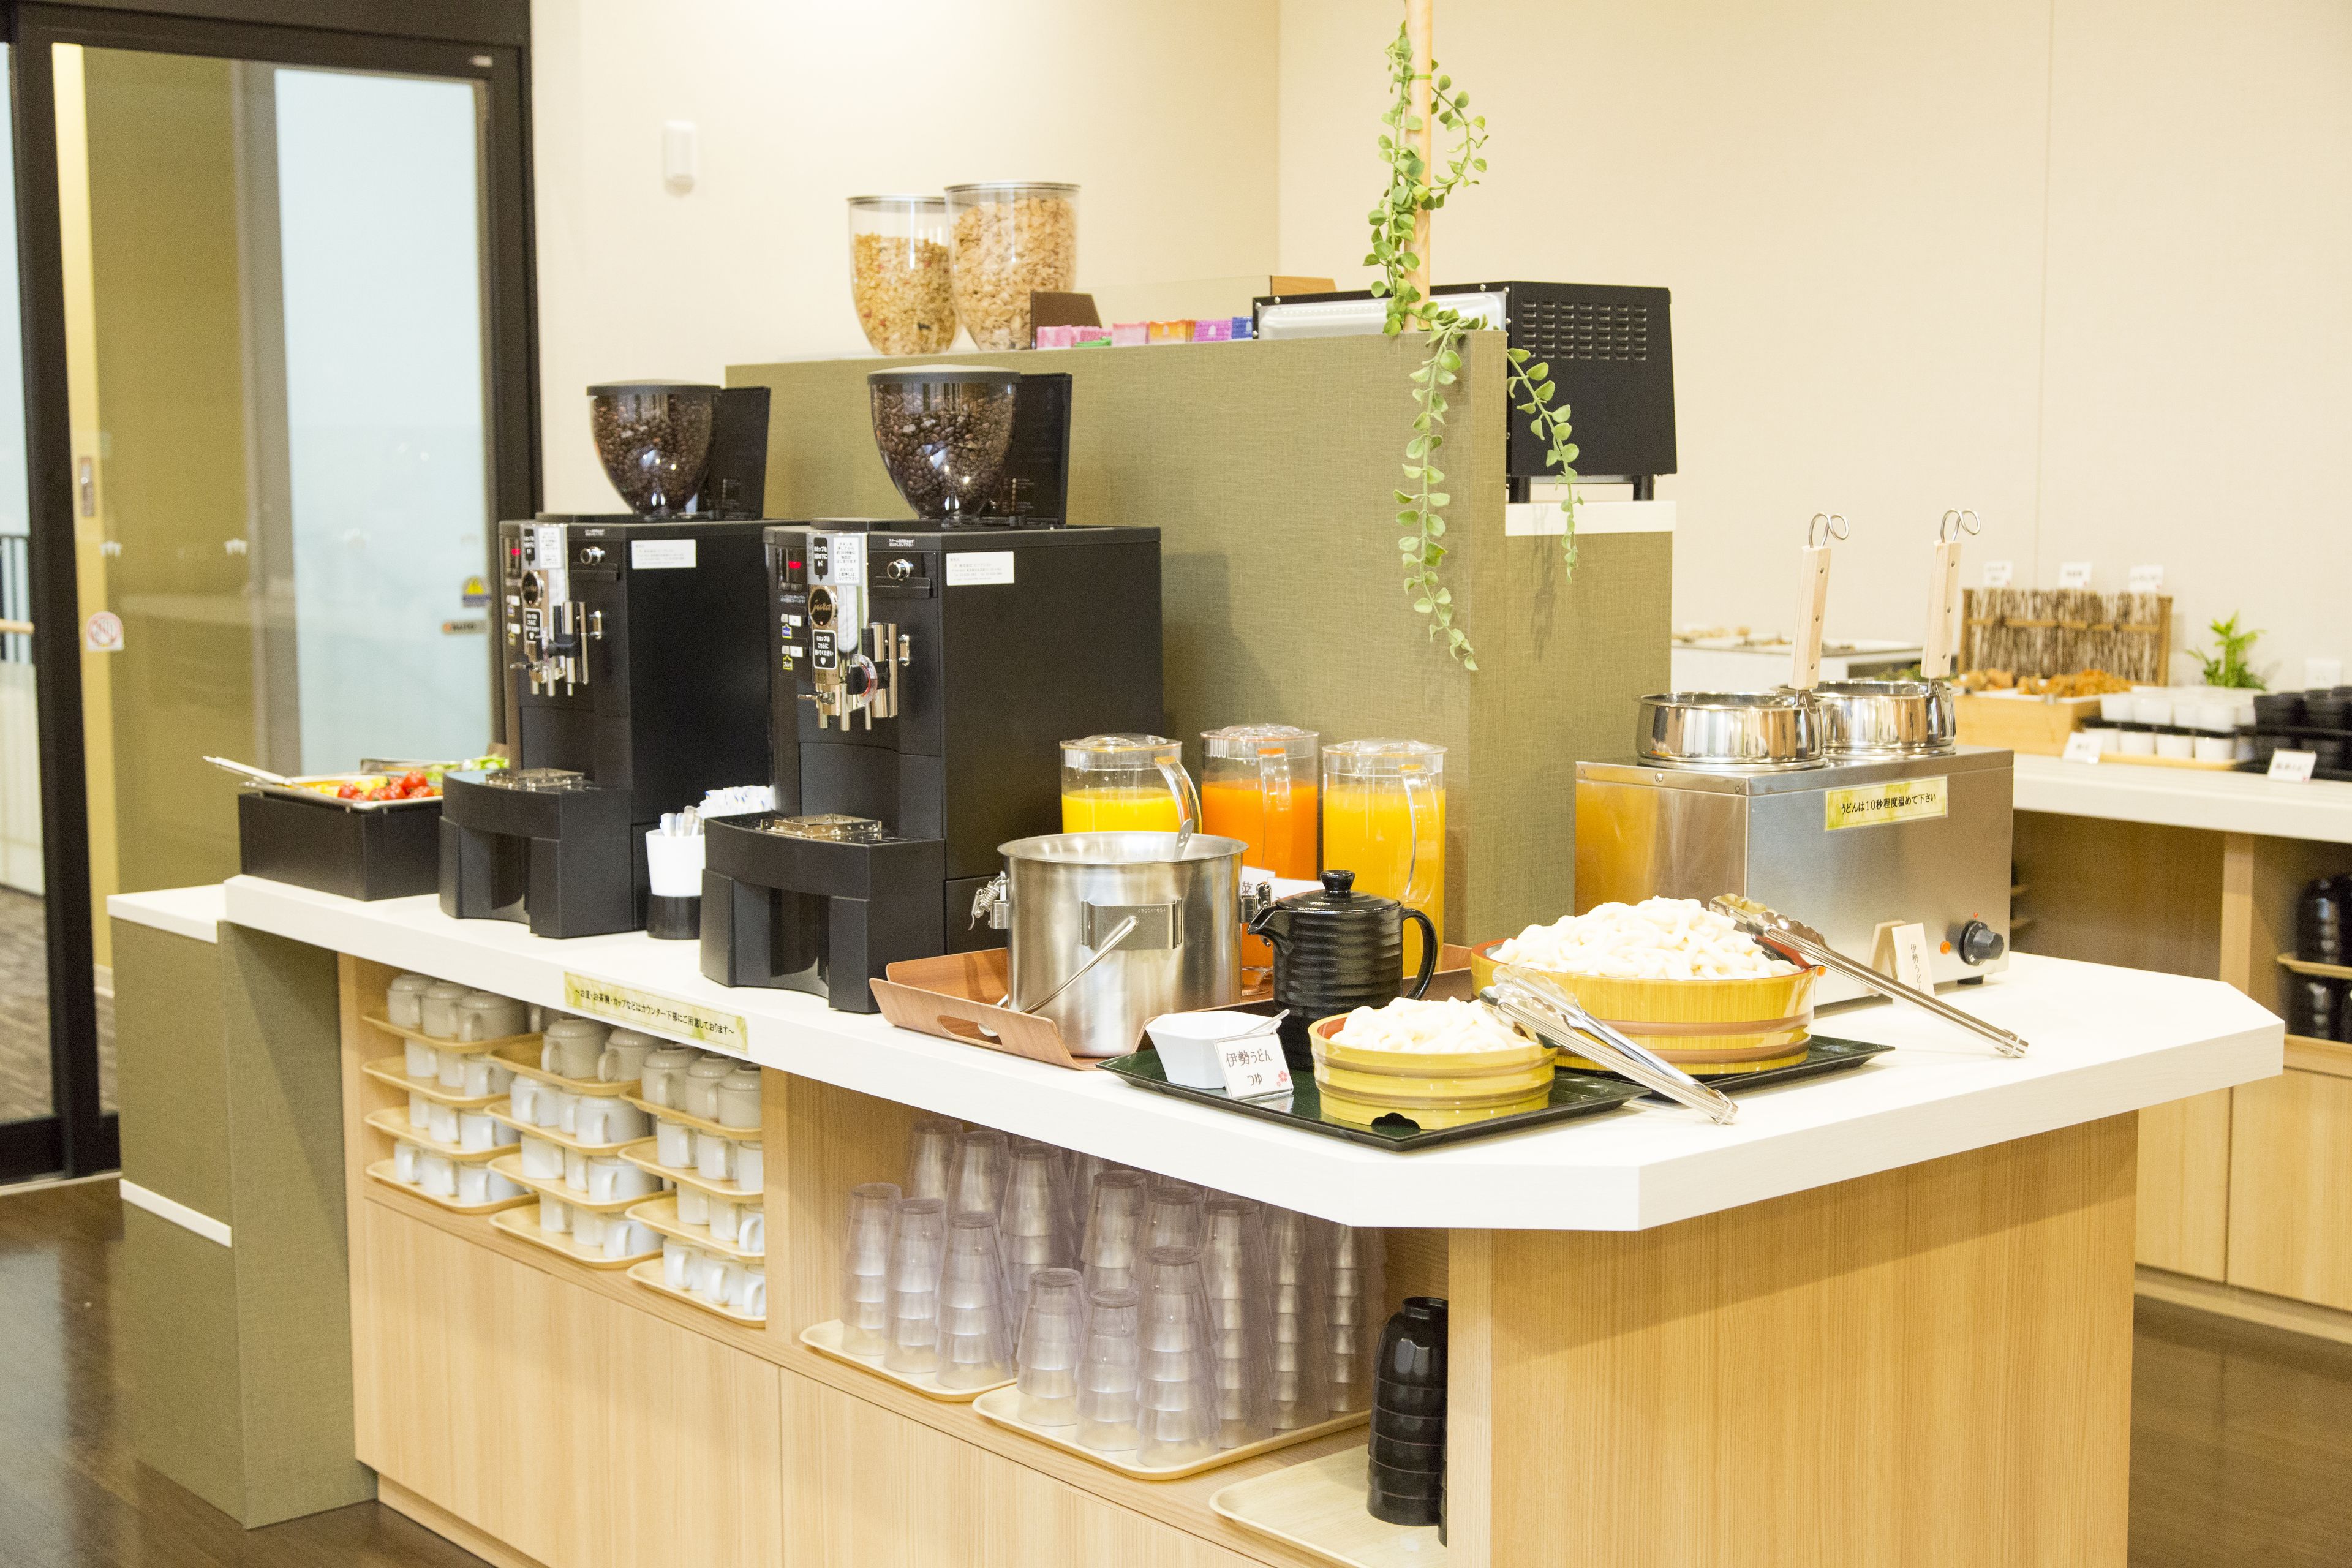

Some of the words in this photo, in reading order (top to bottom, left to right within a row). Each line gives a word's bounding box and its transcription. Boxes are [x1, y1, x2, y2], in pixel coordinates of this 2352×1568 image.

[810, 599, 832, 614] jura
[1841, 793, 1937, 815] うどんは10秒程度温めて下さい
[1226, 1048, 1273, 1068] 伊勢うどん
[1246, 1072, 1262, 1087] つゆ
